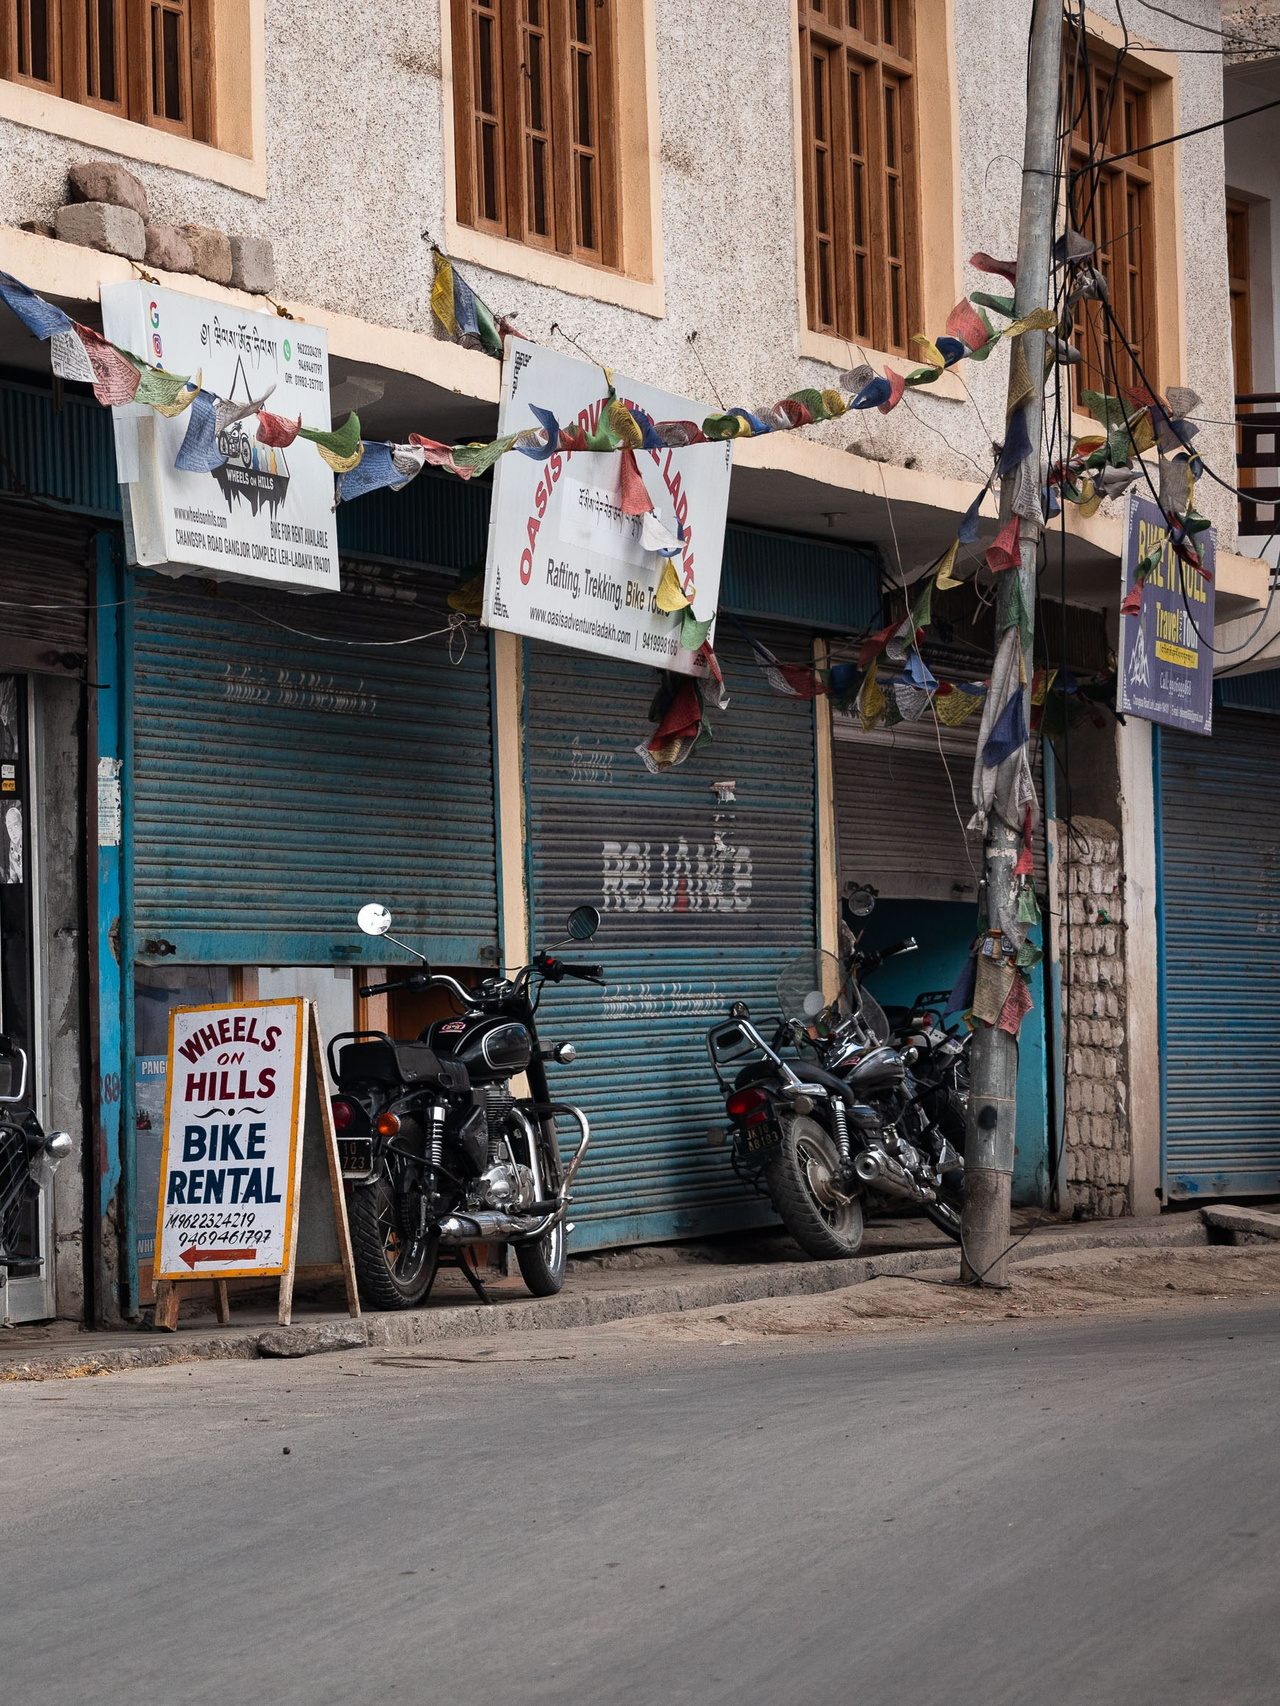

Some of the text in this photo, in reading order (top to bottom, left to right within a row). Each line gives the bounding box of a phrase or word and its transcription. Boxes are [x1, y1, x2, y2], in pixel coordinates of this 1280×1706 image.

[225, 468, 250, 486] WHEELS
[257, 475, 274, 491] HILLS
[270, 520, 329, 549] BIKE FOR RENT AVAILABLE
[520, 449, 695, 606] OASIS LADAK
[174, 528, 206, 549] CHANGSPA
[206, 535, 223, 552] ROAD
[251, 542, 278, 564] COMPLEX
[277, 549, 313, 570] LEH-LADAKH
[546, 558, 581, 600] Rafting,
[584, 568, 623, 612] Trekking,
[625, 580, 645, 610] Bike
[529, 606, 632, 646] www.oasisadventureladakh.com
[1155, 601, 1180, 644] Travel
[177, 1016, 283, 1065] WHEELS
[216, 1051, 245, 1066] ON
[141, 1060, 168, 1076] PANG
[184, 1067, 277, 1103] HILLS
[181, 1122, 267, 1163] BIKE
[166, 1166, 282, 1205] RENTAL
[178, 1229, 272, 1248] 9469461797
